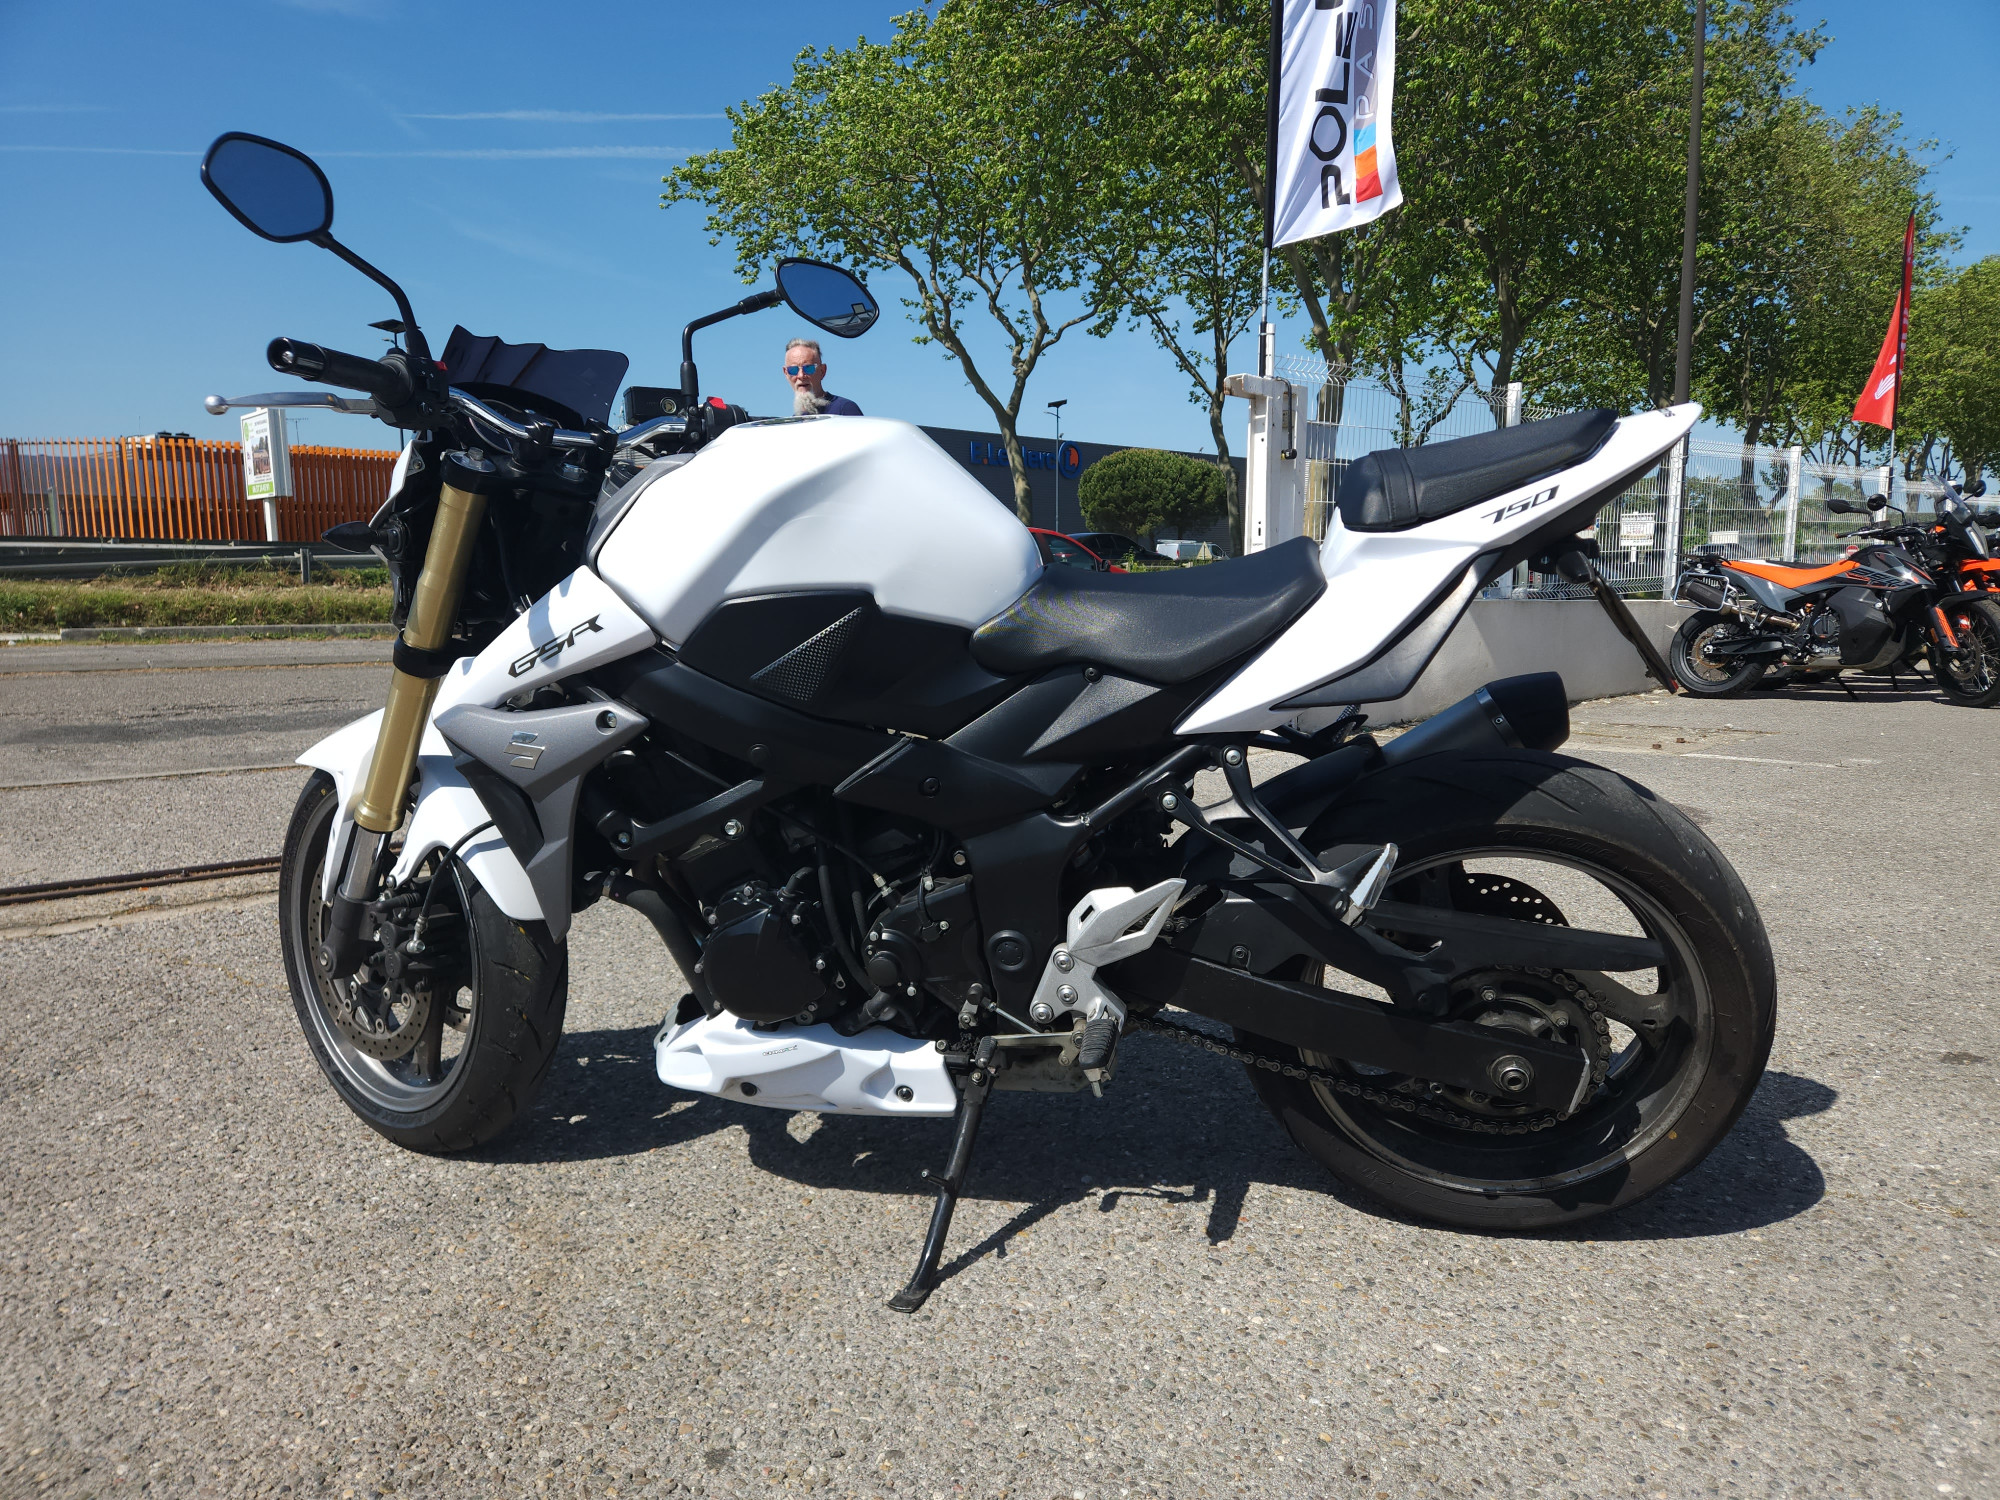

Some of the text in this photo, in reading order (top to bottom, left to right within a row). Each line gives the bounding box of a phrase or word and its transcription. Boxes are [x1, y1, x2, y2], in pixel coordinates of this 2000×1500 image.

[1309, 0, 1358, 209] POLE
[970, 441, 1057, 469] E.Lelerc
[1480, 485, 1560, 524] 750
[508, 613, 604, 678] GSR
